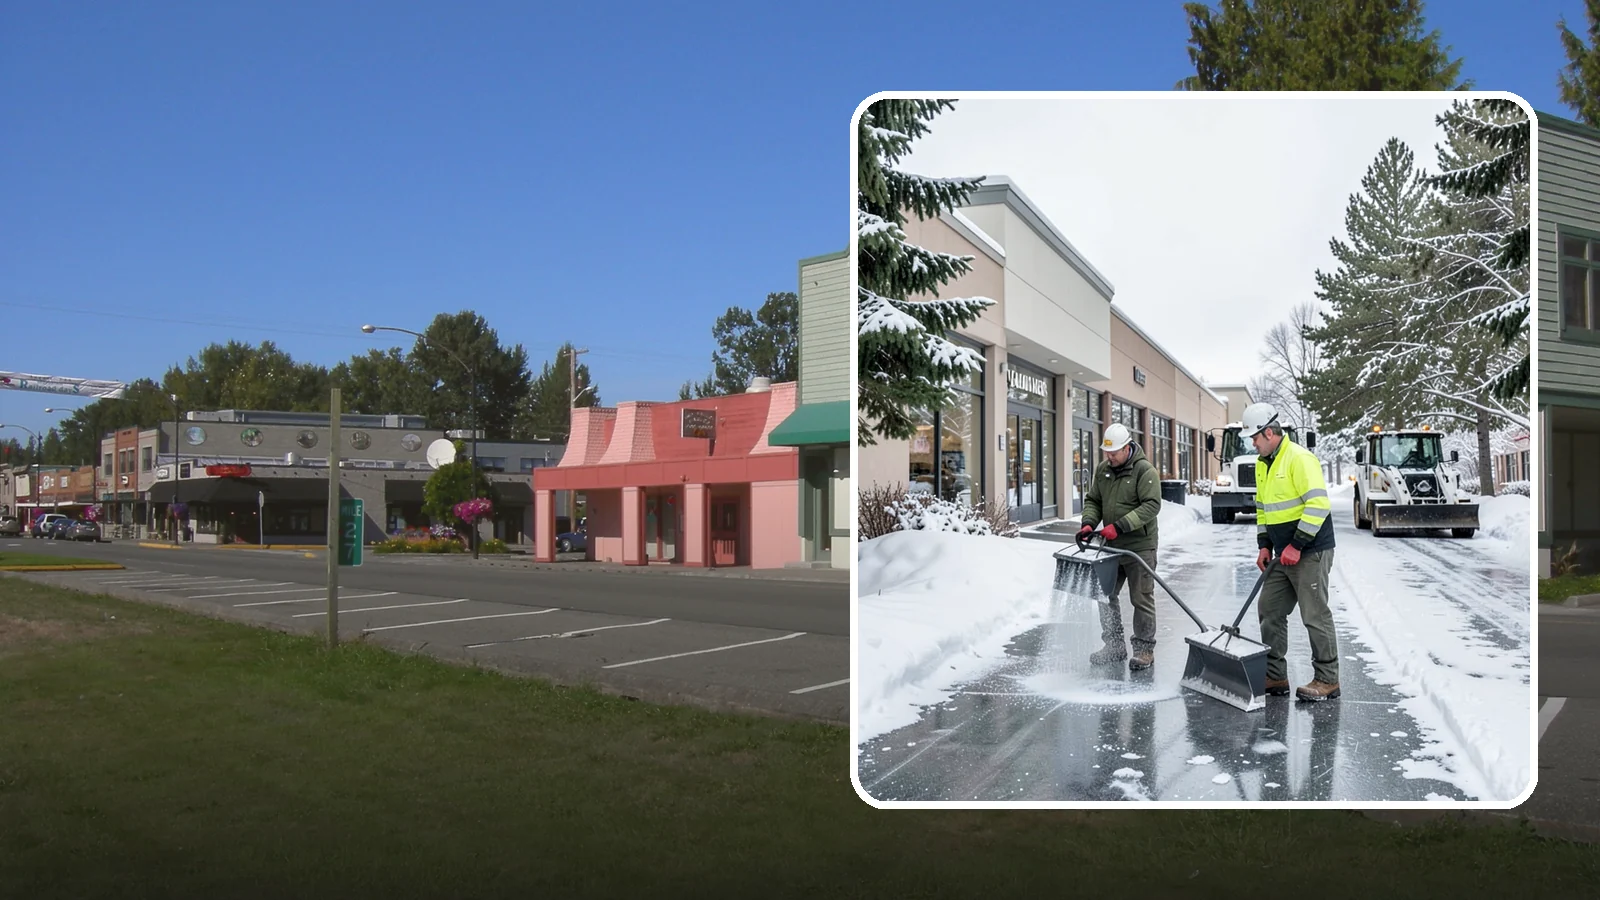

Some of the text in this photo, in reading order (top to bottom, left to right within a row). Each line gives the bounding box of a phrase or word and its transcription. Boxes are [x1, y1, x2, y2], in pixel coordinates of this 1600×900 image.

[20, 379, 56, 391] Railroad
[341, 505, 361, 516] MILE
[344, 522, 356, 538] 2
